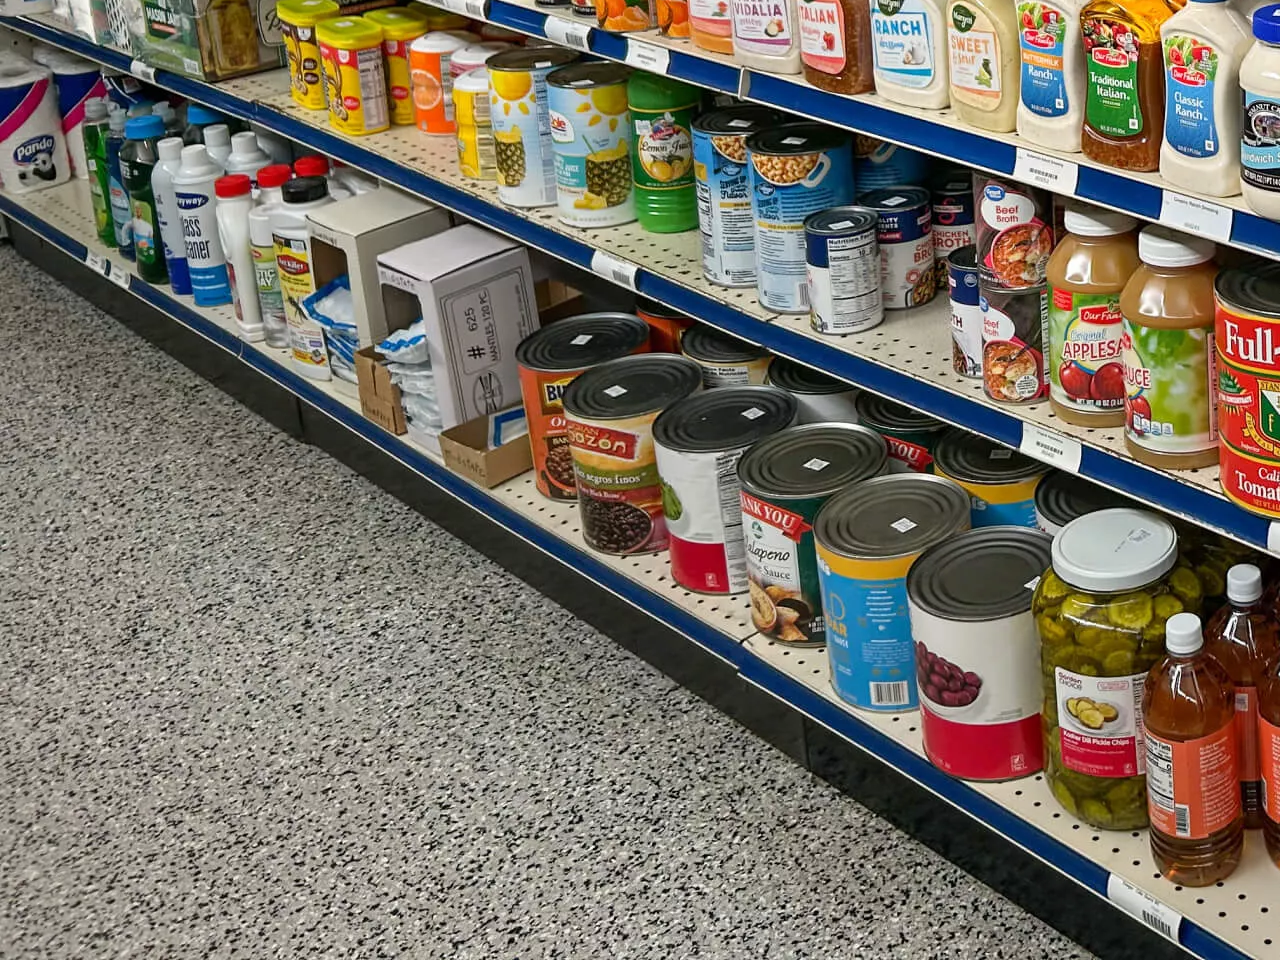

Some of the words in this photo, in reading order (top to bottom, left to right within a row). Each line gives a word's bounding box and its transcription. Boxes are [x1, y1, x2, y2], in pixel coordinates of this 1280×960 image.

[734, 3, 783, 17] VIDALIA
[874, 20, 922, 36] RANCH
[951, 36, 990, 54] SWEET
[1028, 65, 1053, 80] Ranch
[1090, 73, 1134, 89] Traditional
[1097, 86, 1126, 100] Italian
[1174, 92, 1204, 108] Classic
[1175, 104, 1202, 120] Ranch
[16, 138, 53, 158] Panda
[641, 142, 668, 154] Lemon
[996, 204, 1019, 214] Beef
[996, 213, 1019, 223] Broth
[932, 230, 969, 239] CHICKEN
[186, 240, 210, 260] eaner
[464, 307, 479, 332] 625
[483, 321, 499, 362] MANTLES
[468, 345, 485, 359] #
[764, 506, 795, 529] YOU
[763, 565, 791, 580] Sauce
[1112, 737, 1130, 747] Chips
